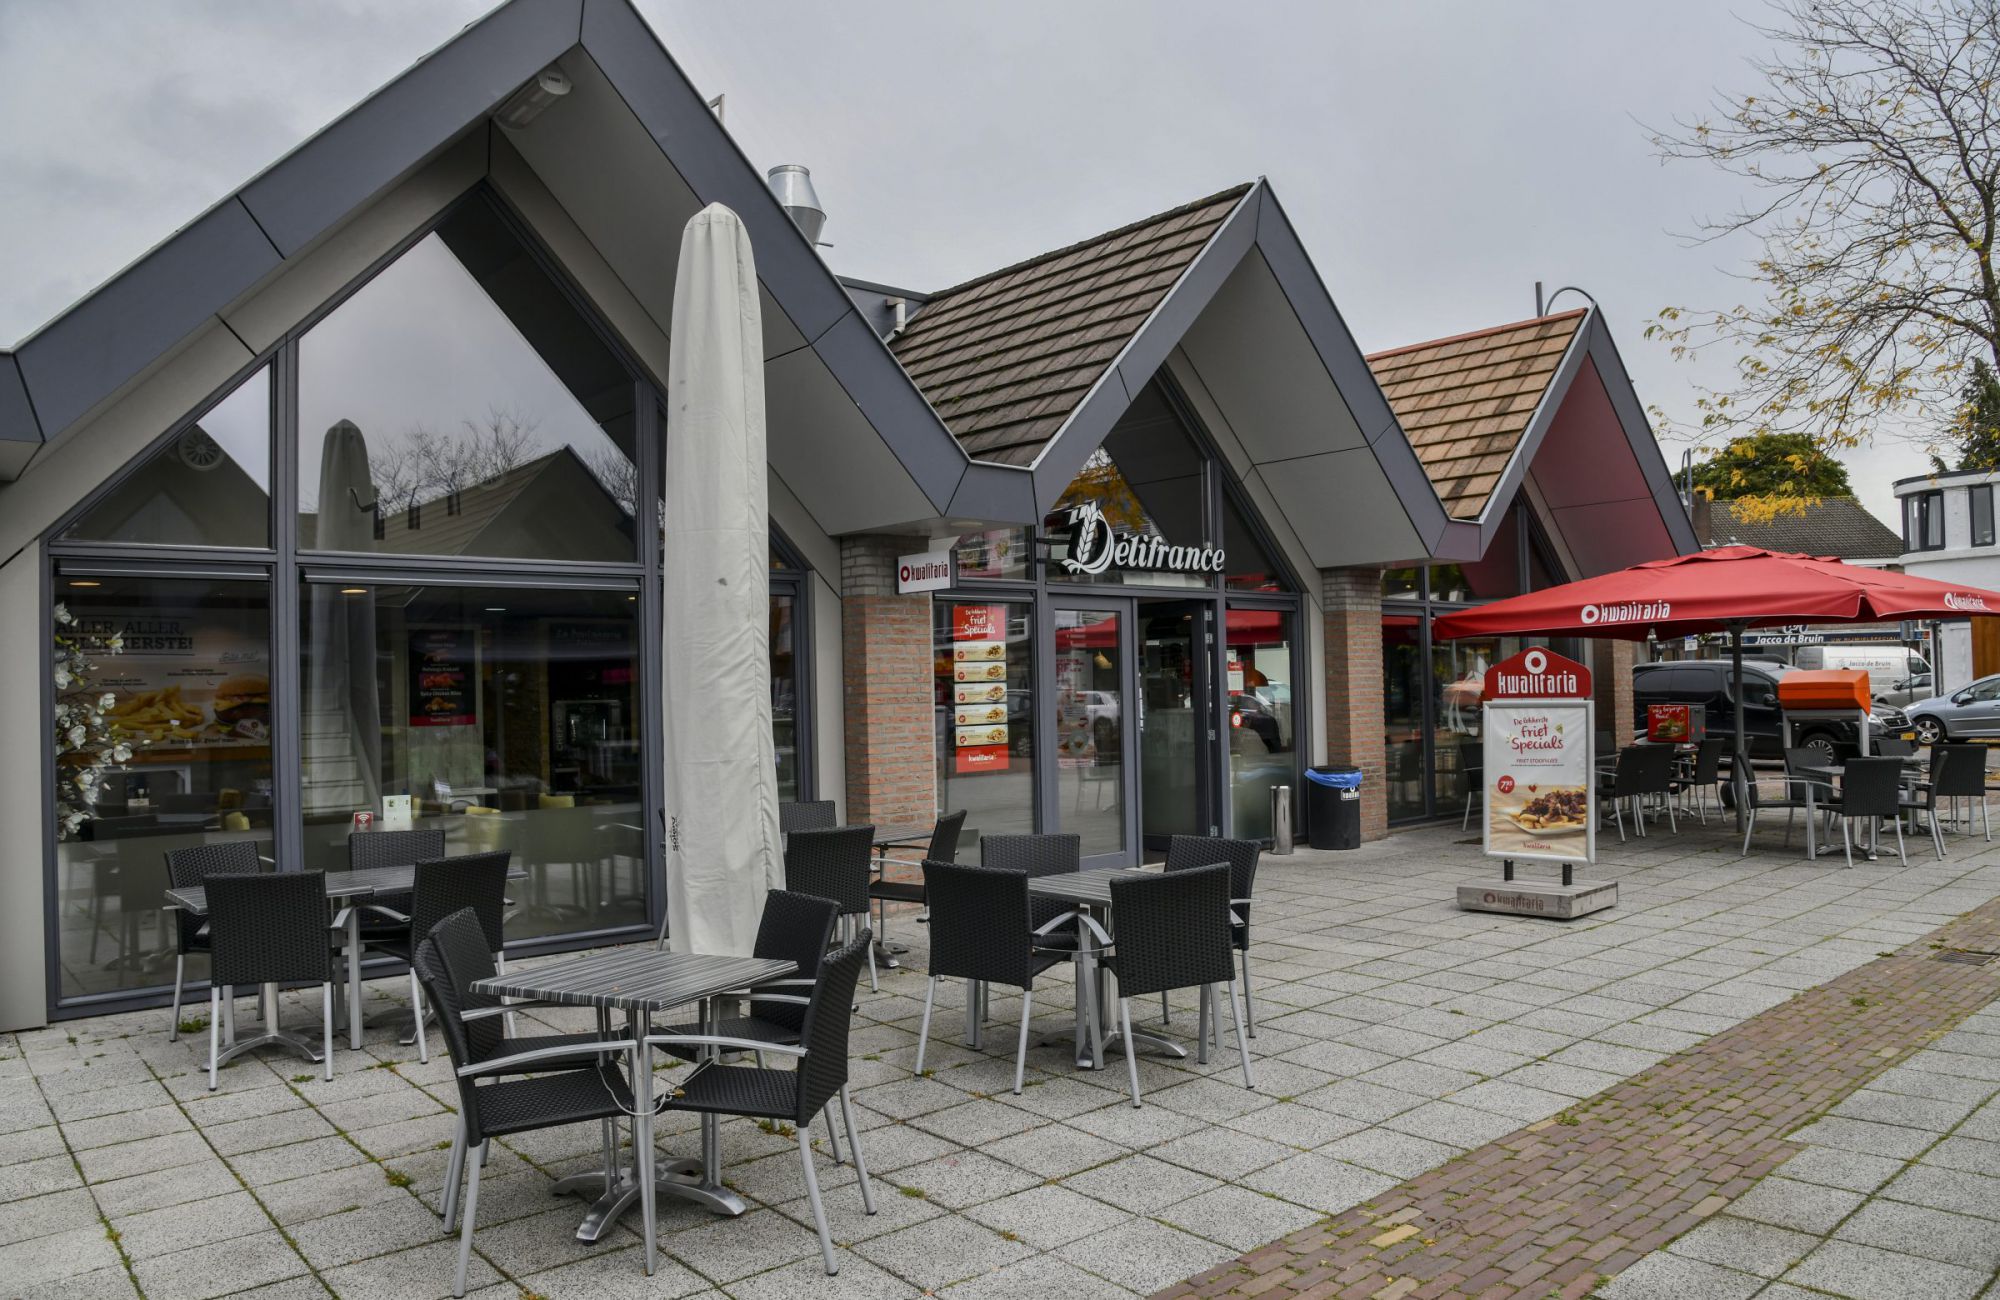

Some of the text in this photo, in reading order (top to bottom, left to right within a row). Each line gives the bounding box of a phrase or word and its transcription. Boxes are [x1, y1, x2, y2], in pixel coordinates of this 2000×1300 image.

[1061, 500, 1226, 575] Délifrance
[911, 561, 949, 582] kwalitaria
[1600, 600, 1671, 623] kwalitaria
[123, 621, 185, 637] ALLER,
[964, 623, 996, 638] Specials
[1755, 636, 1782, 644] Jacco
[1784, 635, 1796, 644] de
[1798, 634, 1824, 644] Bruin
[1498, 670, 1577, 694] kwalitaria
[1521, 723, 1549, 738] friet
[1511, 735, 1564, 755] Specials
